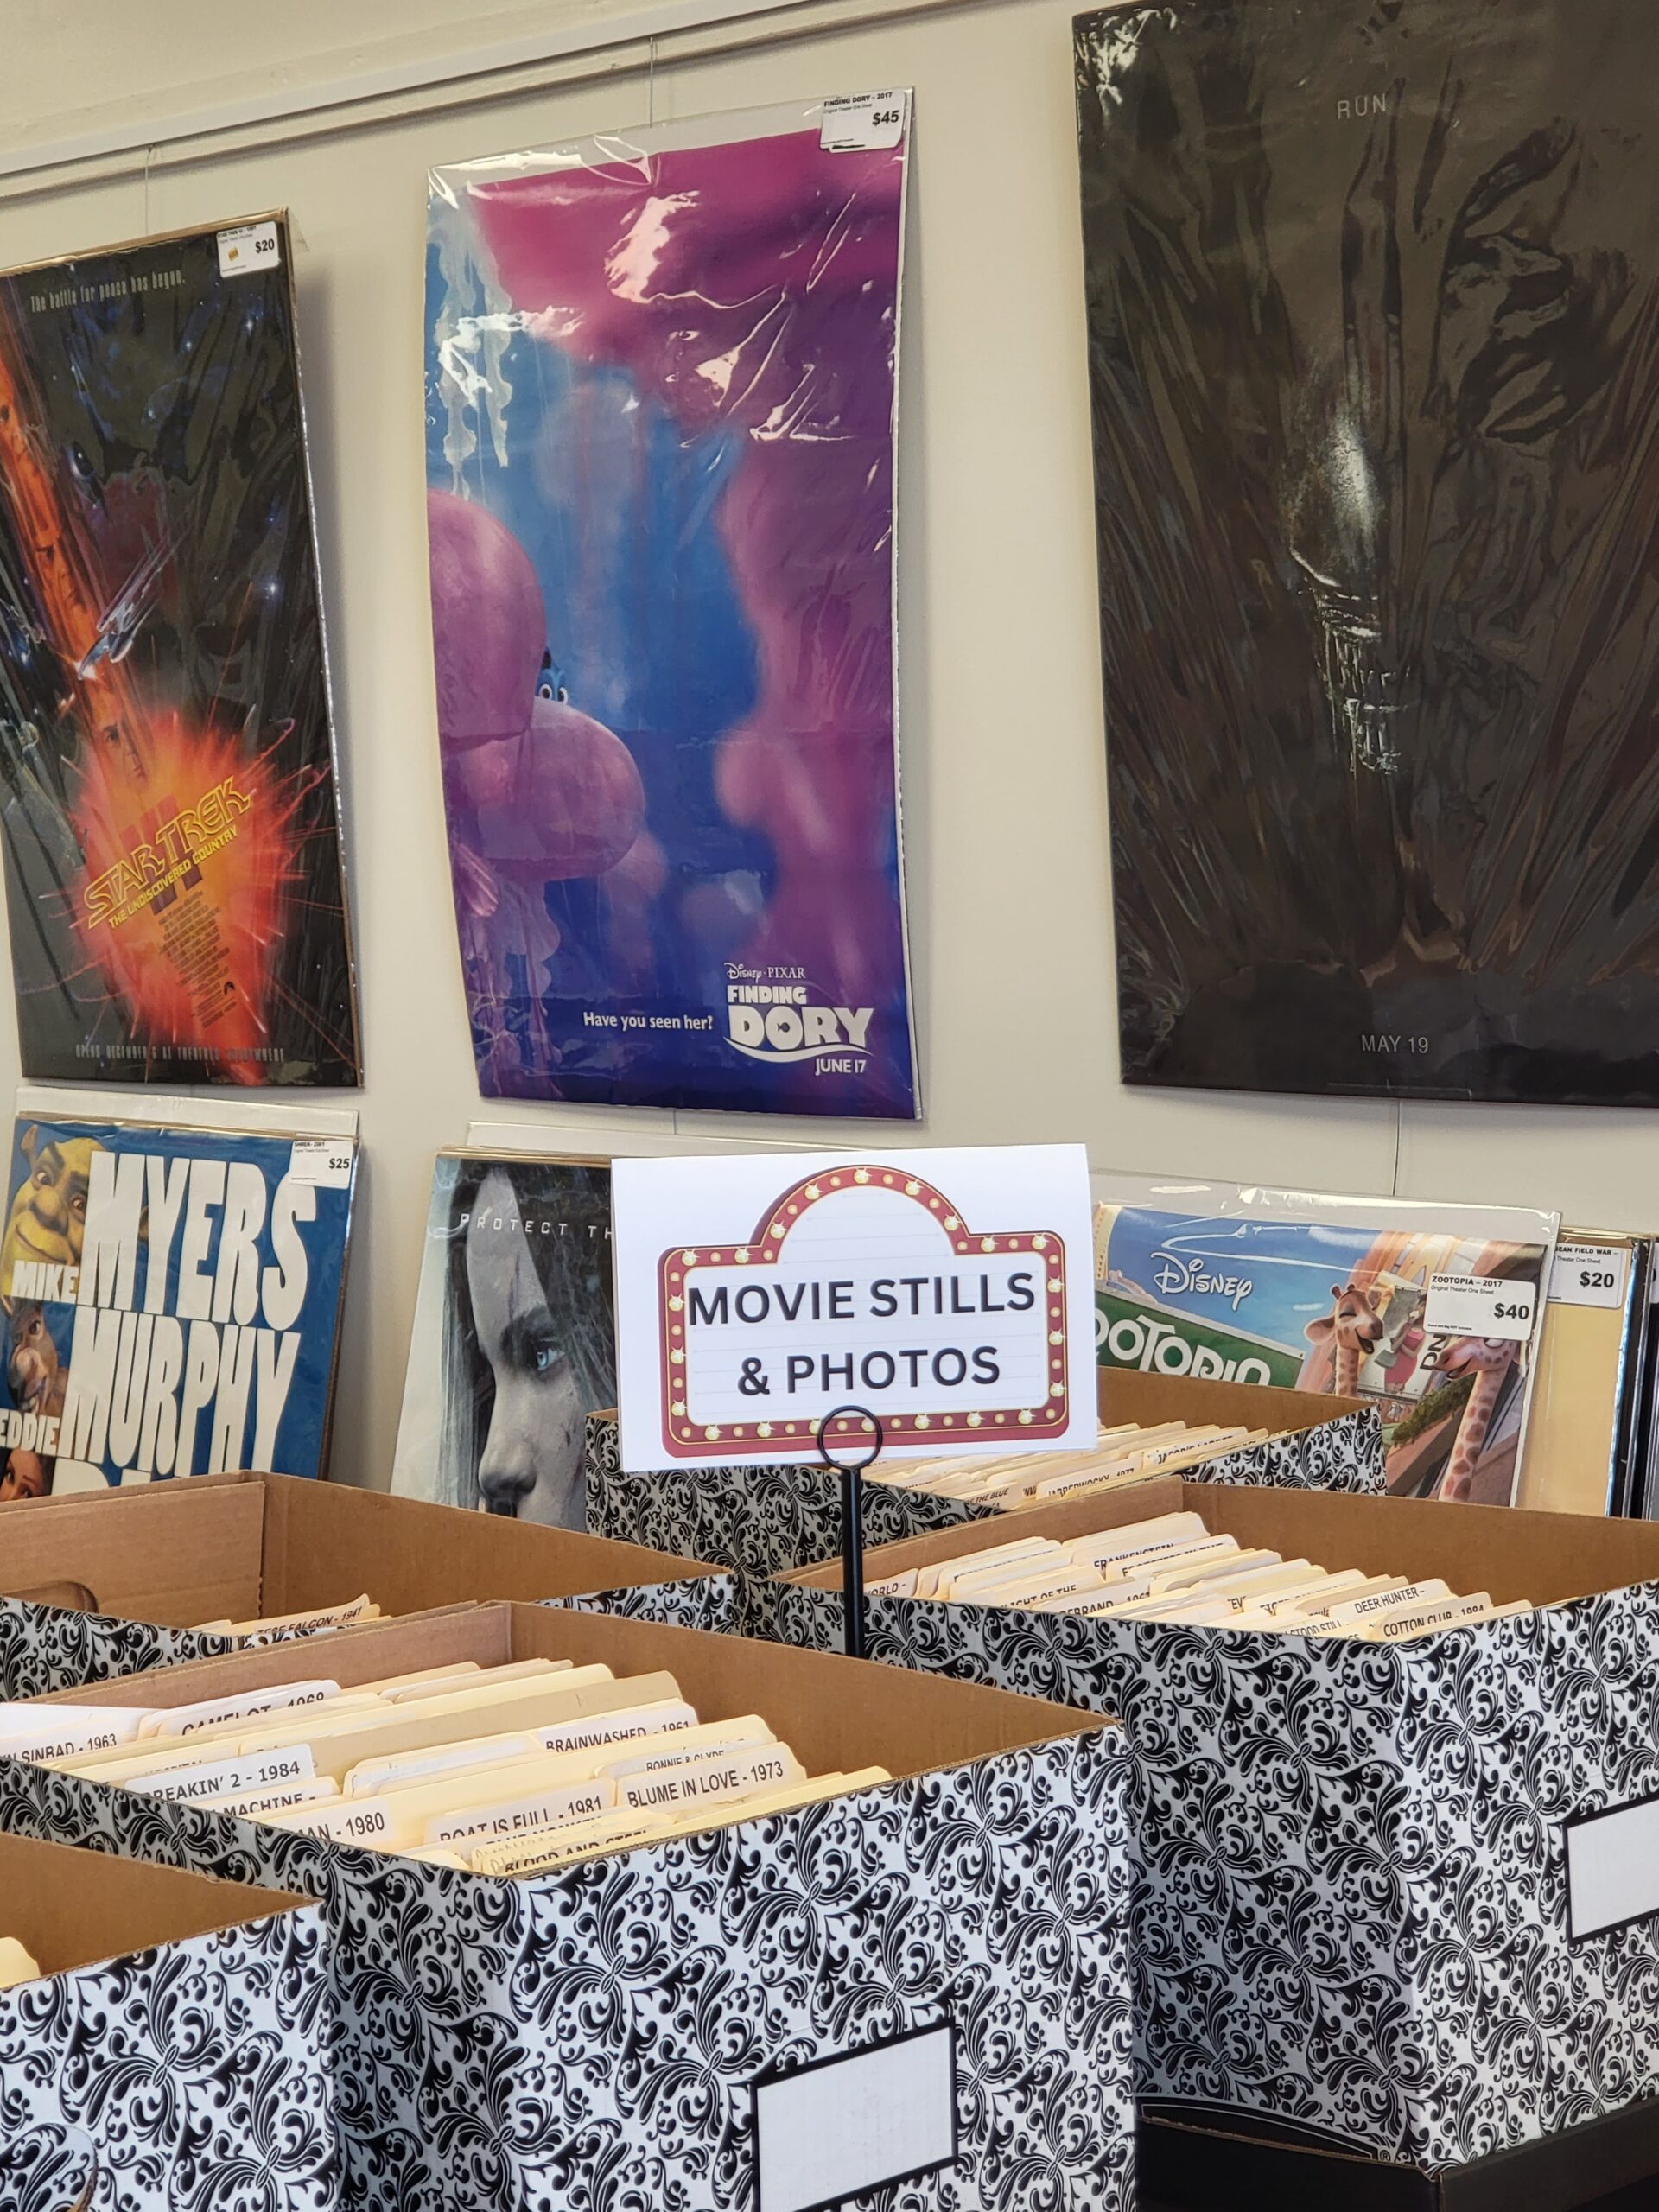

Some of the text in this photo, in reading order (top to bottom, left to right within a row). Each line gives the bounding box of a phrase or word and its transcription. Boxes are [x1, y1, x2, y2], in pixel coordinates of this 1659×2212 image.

[823, 98, 851, 107] FINDING
[1337, 93, 1387, 119] RUN
[872, 110, 899, 127] $45
[255, 238, 275, 254] $20
[30, 296, 46, 313] The
[48, 289, 77, 309] battle
[80, 285, 95, 302] for
[99, 280, 127, 302] peace
[130, 276, 148, 294] has
[84, 775, 251, 930] STAR TREK
[108, 825, 238, 929] THE UNDISCOVERED COUNTRY
[767, 966, 806, 979] PIXAR
[727, 985, 807, 1005] FINDING
[583, 1012, 713, 1032] Have you seen her?
[728, 1005, 874, 1051] DORY
[1361, 1034, 1429, 1055] MAY 19
[815, 1058, 867, 1077] JUNE 17
[328, 1158, 350, 1169] $25
[461, 1213, 568, 1236] PROTECT
[78, 1150, 317, 1331] MYERS
[10, 1259, 79, 1302] MIKE
[1432, 1275, 1474, 1285] ZOOTOPIA
[1580, 1271, 1614, 1288] $20
[689, 1272, 1036, 1326] MOVIE STILLS
[1493, 1302, 1529, 1320] $40
[737, 1344, 1001, 1397] & PHOTOS
[57, 1306, 301, 1477] MURPHY
[0, 1408, 60, 1455] EDDIE
[990, 1488, 1009, 1499] BLUE
[866, 1583, 898, 1597] ORLD
[1354, 1599, 1382, 1614] DEER
[1382, 1586, 1420, 1606] HUNTER
[287, 1615, 334, 1631] FALCON
[341, 1606, 362, 1622] 1941
[1383, 1617, 1425, 1637] COTTON
[22, 1741, 74, 1763] SINBAD
[87, 1733, 117, 1751] 1963
[546, 1727, 646, 1752] BRAINWASHED
[231, 1773, 241, 1788] 2
[258, 1761, 300, 1782] 1984
[627, 1783, 678, 1807] BLUME
[682, 1778, 696, 1797] IN
[700, 1770, 740, 1793] LOVE
[751, 1761, 783, 1782] 1973
[346, 1812, 385, 1837] 1980
[493, 1819, 508, 1834] IS
